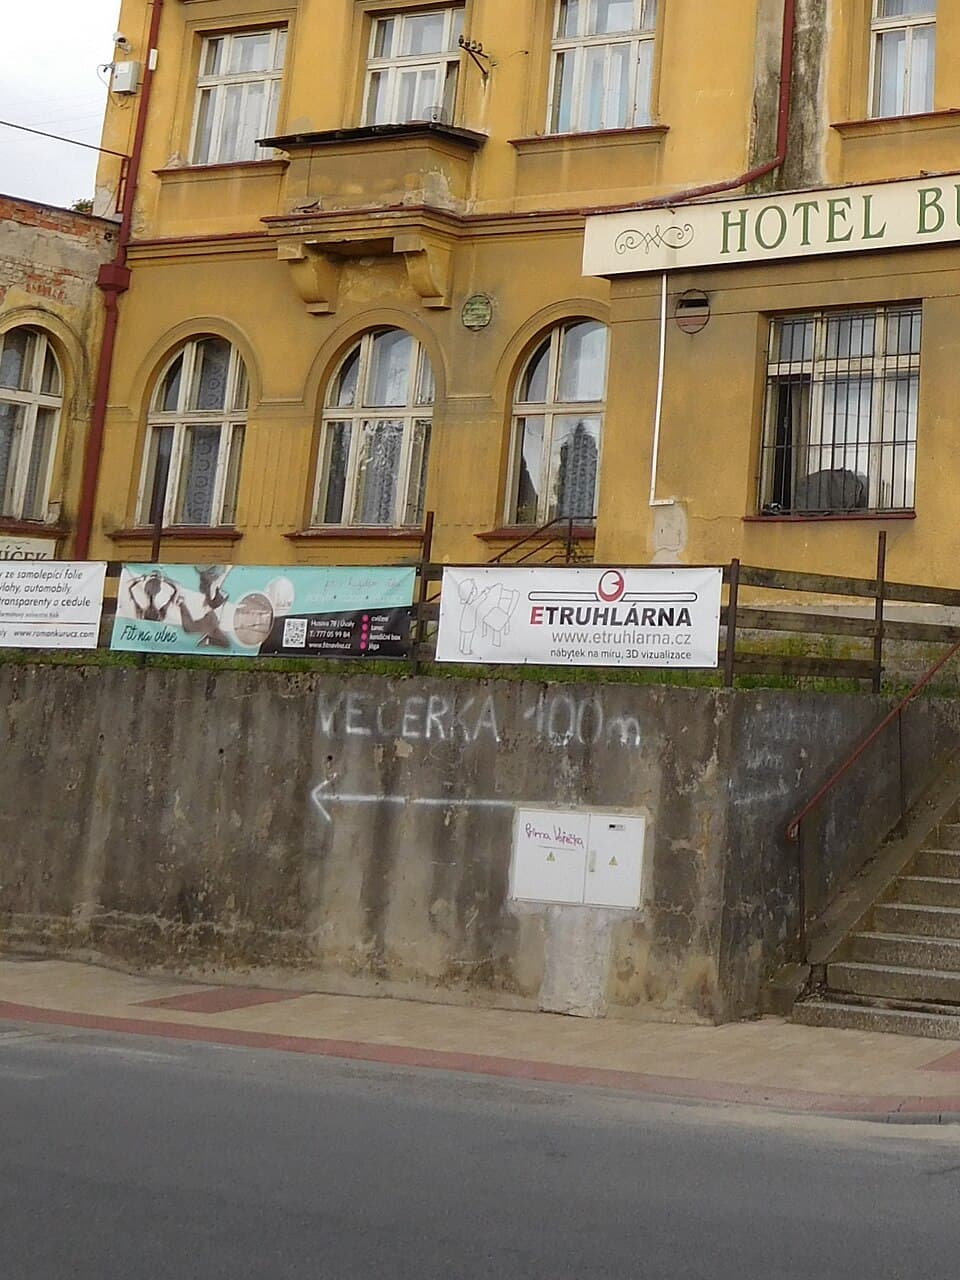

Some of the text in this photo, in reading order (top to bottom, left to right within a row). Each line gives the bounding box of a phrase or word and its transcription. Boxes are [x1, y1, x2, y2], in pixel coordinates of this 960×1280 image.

[720, 194, 887, 254] HOTEL
[61, 596, 91, 607] cedule
[530, 603, 692, 627] ETRUHLÁRNA
[551, 629, 692, 645] www.etruhlarna.cz
[550, 647, 585, 659] nábytek
[587, 650, 598, 658] na
[625, 649, 639, 659] 3D
[640, 650, 692, 660] vizualizace
